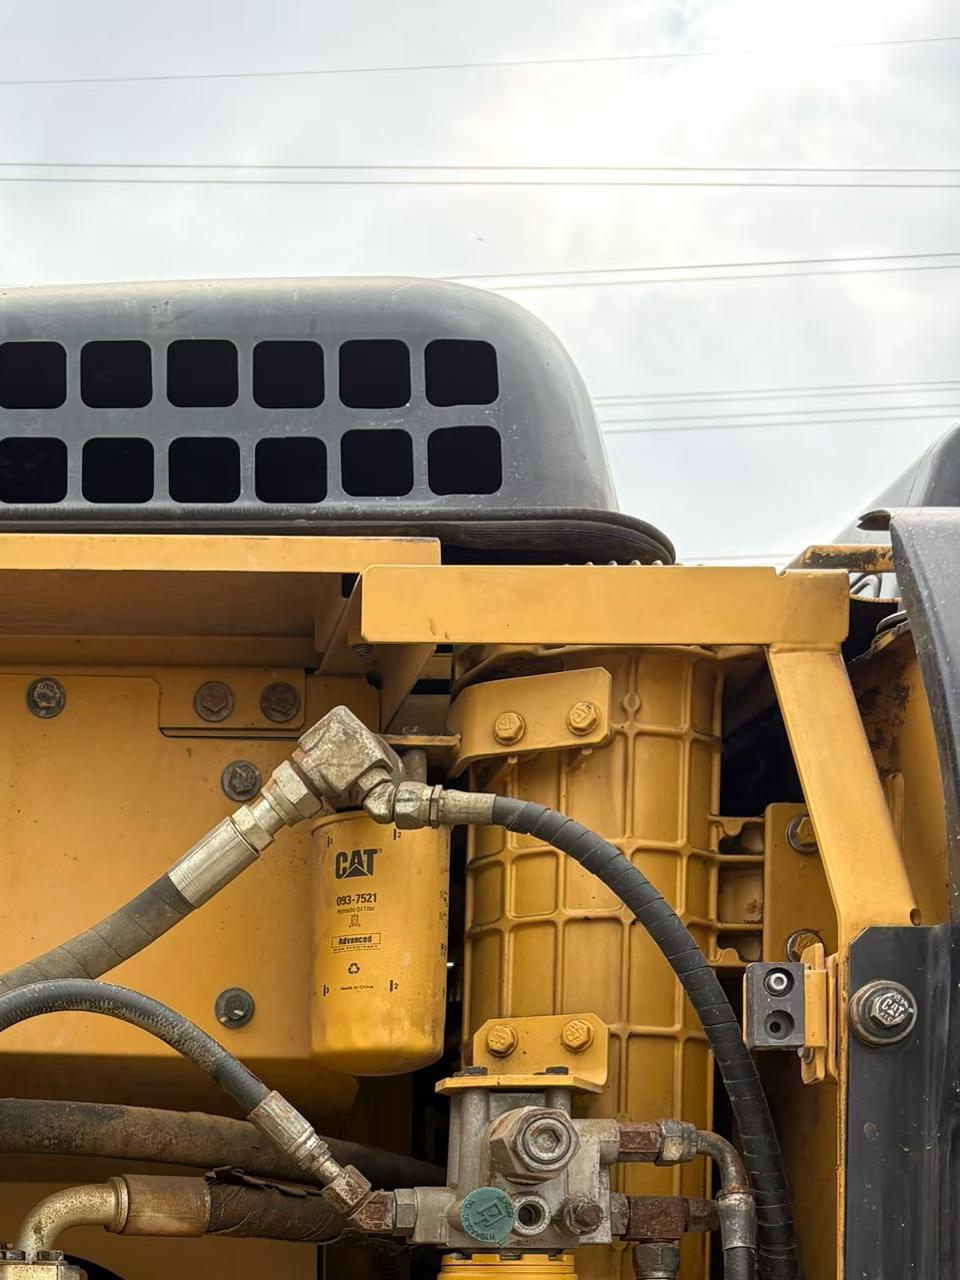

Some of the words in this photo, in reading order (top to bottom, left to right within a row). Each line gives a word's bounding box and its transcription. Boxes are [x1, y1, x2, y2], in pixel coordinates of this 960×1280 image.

[335, 848, 378, 880] CAT
[336, 893, 377, 906] 093-7521
[338, 935, 372, 946] Advanced
